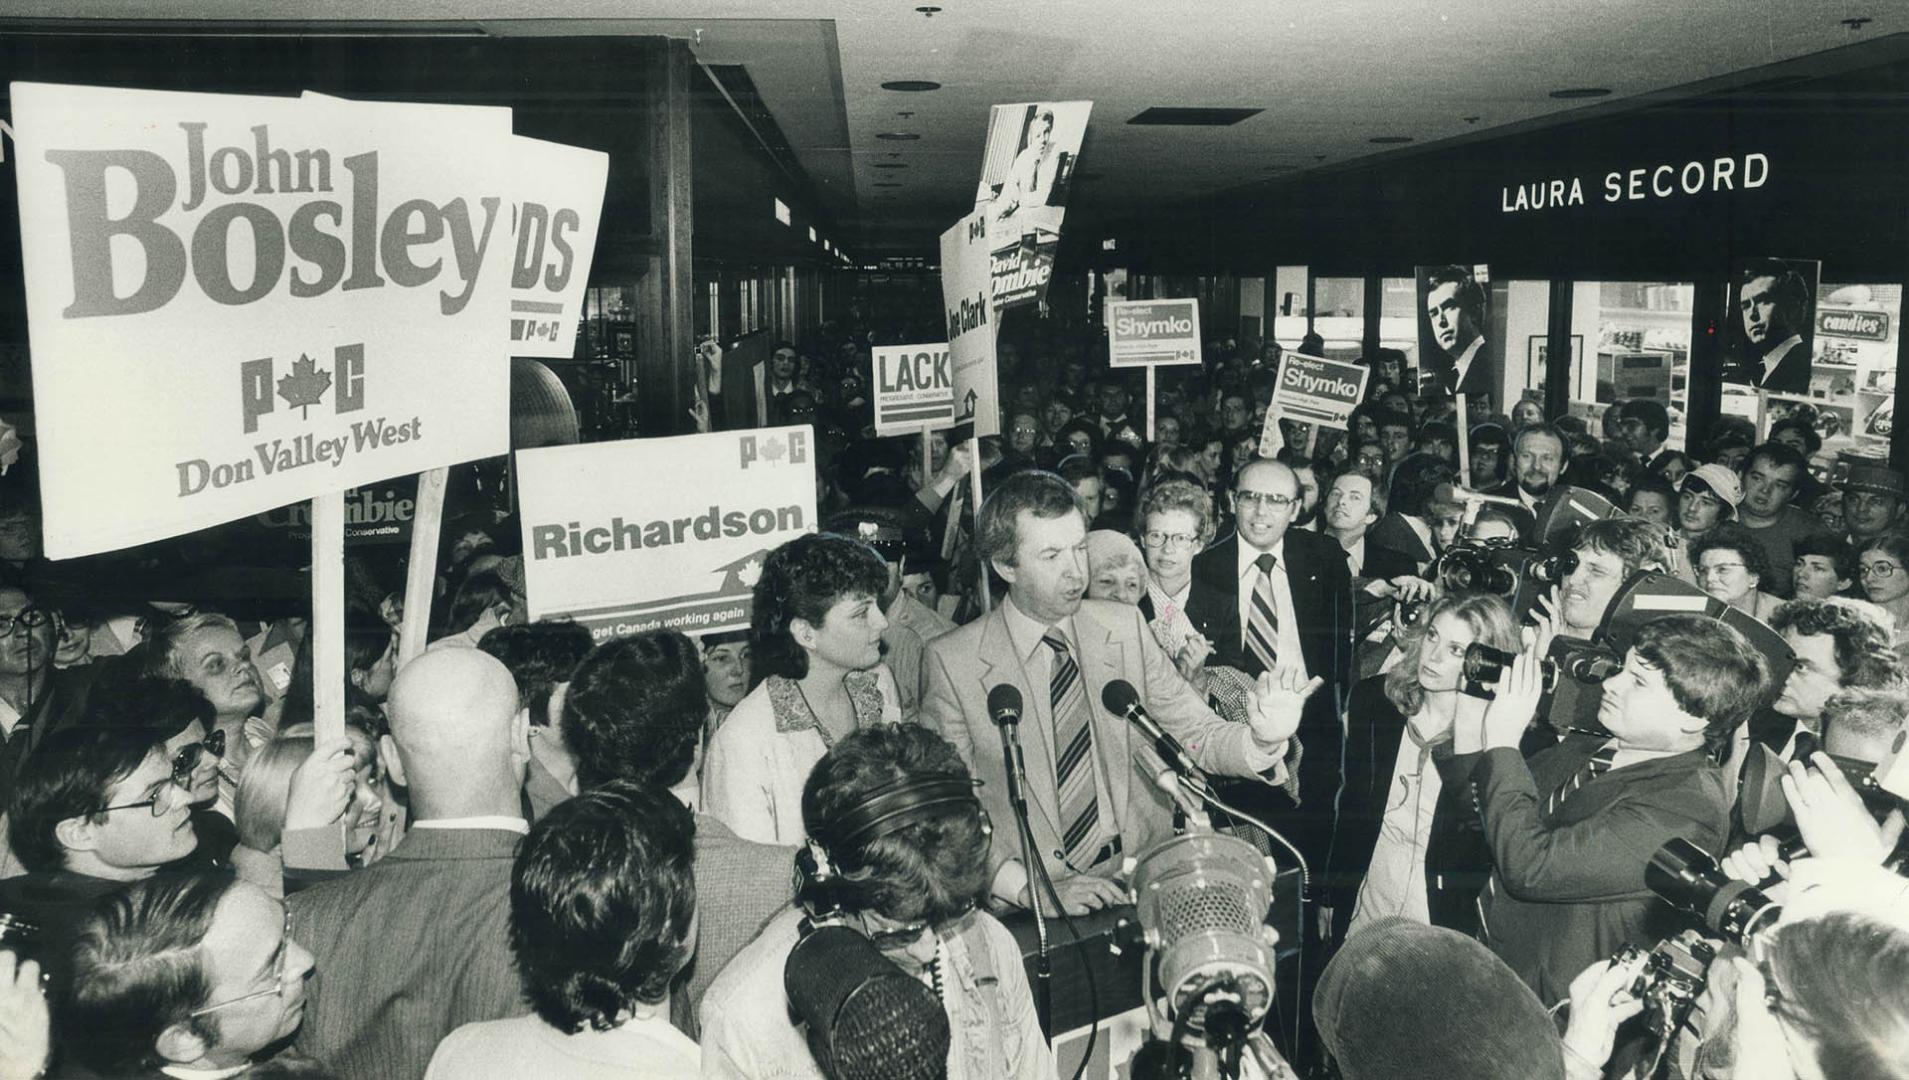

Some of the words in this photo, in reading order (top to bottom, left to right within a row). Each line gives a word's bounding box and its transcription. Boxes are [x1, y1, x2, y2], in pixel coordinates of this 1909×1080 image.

[178, 121, 334, 212] John
[1502, 177, 1584, 212] LAURA
[1604, 152, 1769, 202] SECORD
[44, 149, 501, 318] Bosley
[511, 202, 580, 293] DS
[991, 258, 1052, 297] ombie
[960, 291, 987, 333] Clark
[1116, 315, 1192, 338] Shymko
[1823, 314, 1880, 334] candies
[879, 351, 950, 393] LACK
[1284, 367, 1358, 397] Shymko
[176, 458, 255, 498] Don
[254, 433, 349, 475] Valley
[350, 416, 422, 454] West
[532, 504, 804, 561] Richardson
[592, 626, 613, 640] get
[616, 618, 662, 635] Canada
[664, 612, 710, 627] working
[712, 607, 745, 622] again
